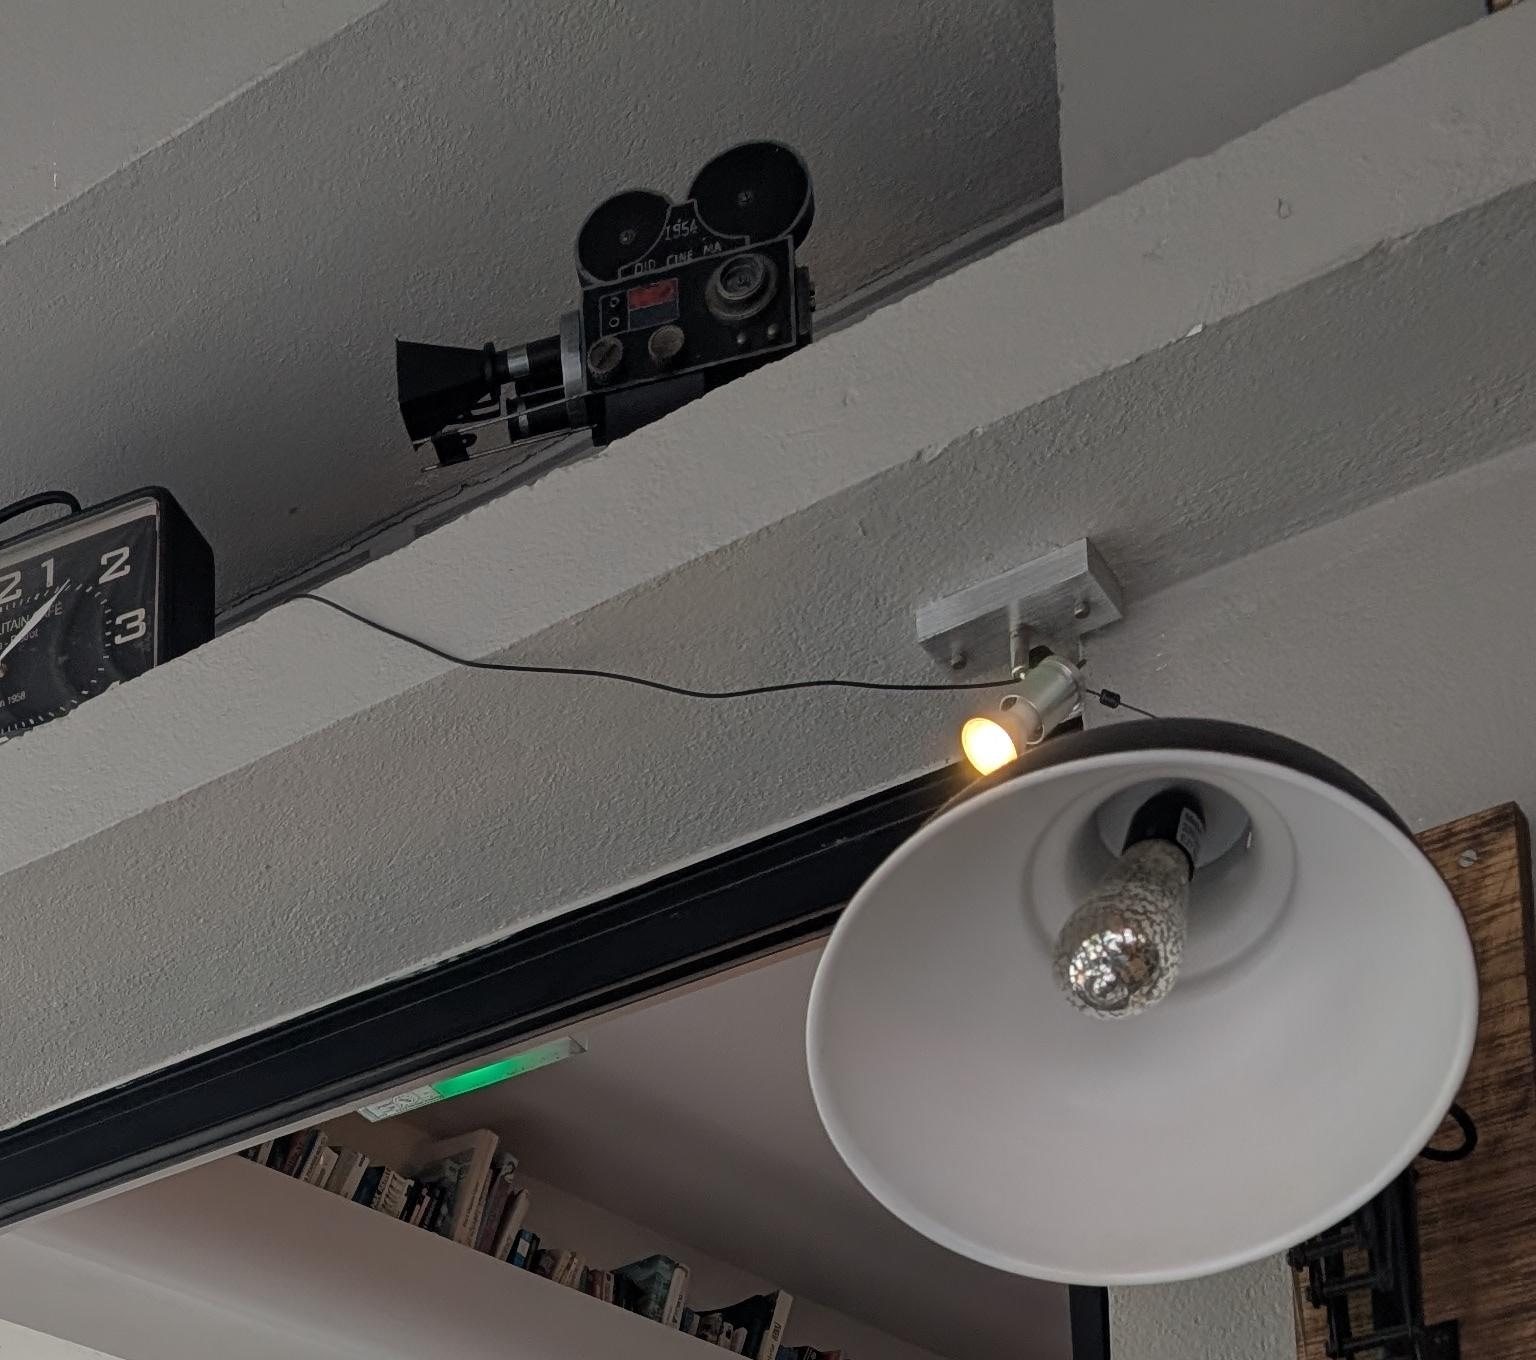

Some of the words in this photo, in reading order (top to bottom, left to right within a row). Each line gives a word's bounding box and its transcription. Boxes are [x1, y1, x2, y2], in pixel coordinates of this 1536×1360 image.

[41, 557, 54, 588] 1
[98, 546, 131, 584] 2
[114, 607, 147, 646] 3
